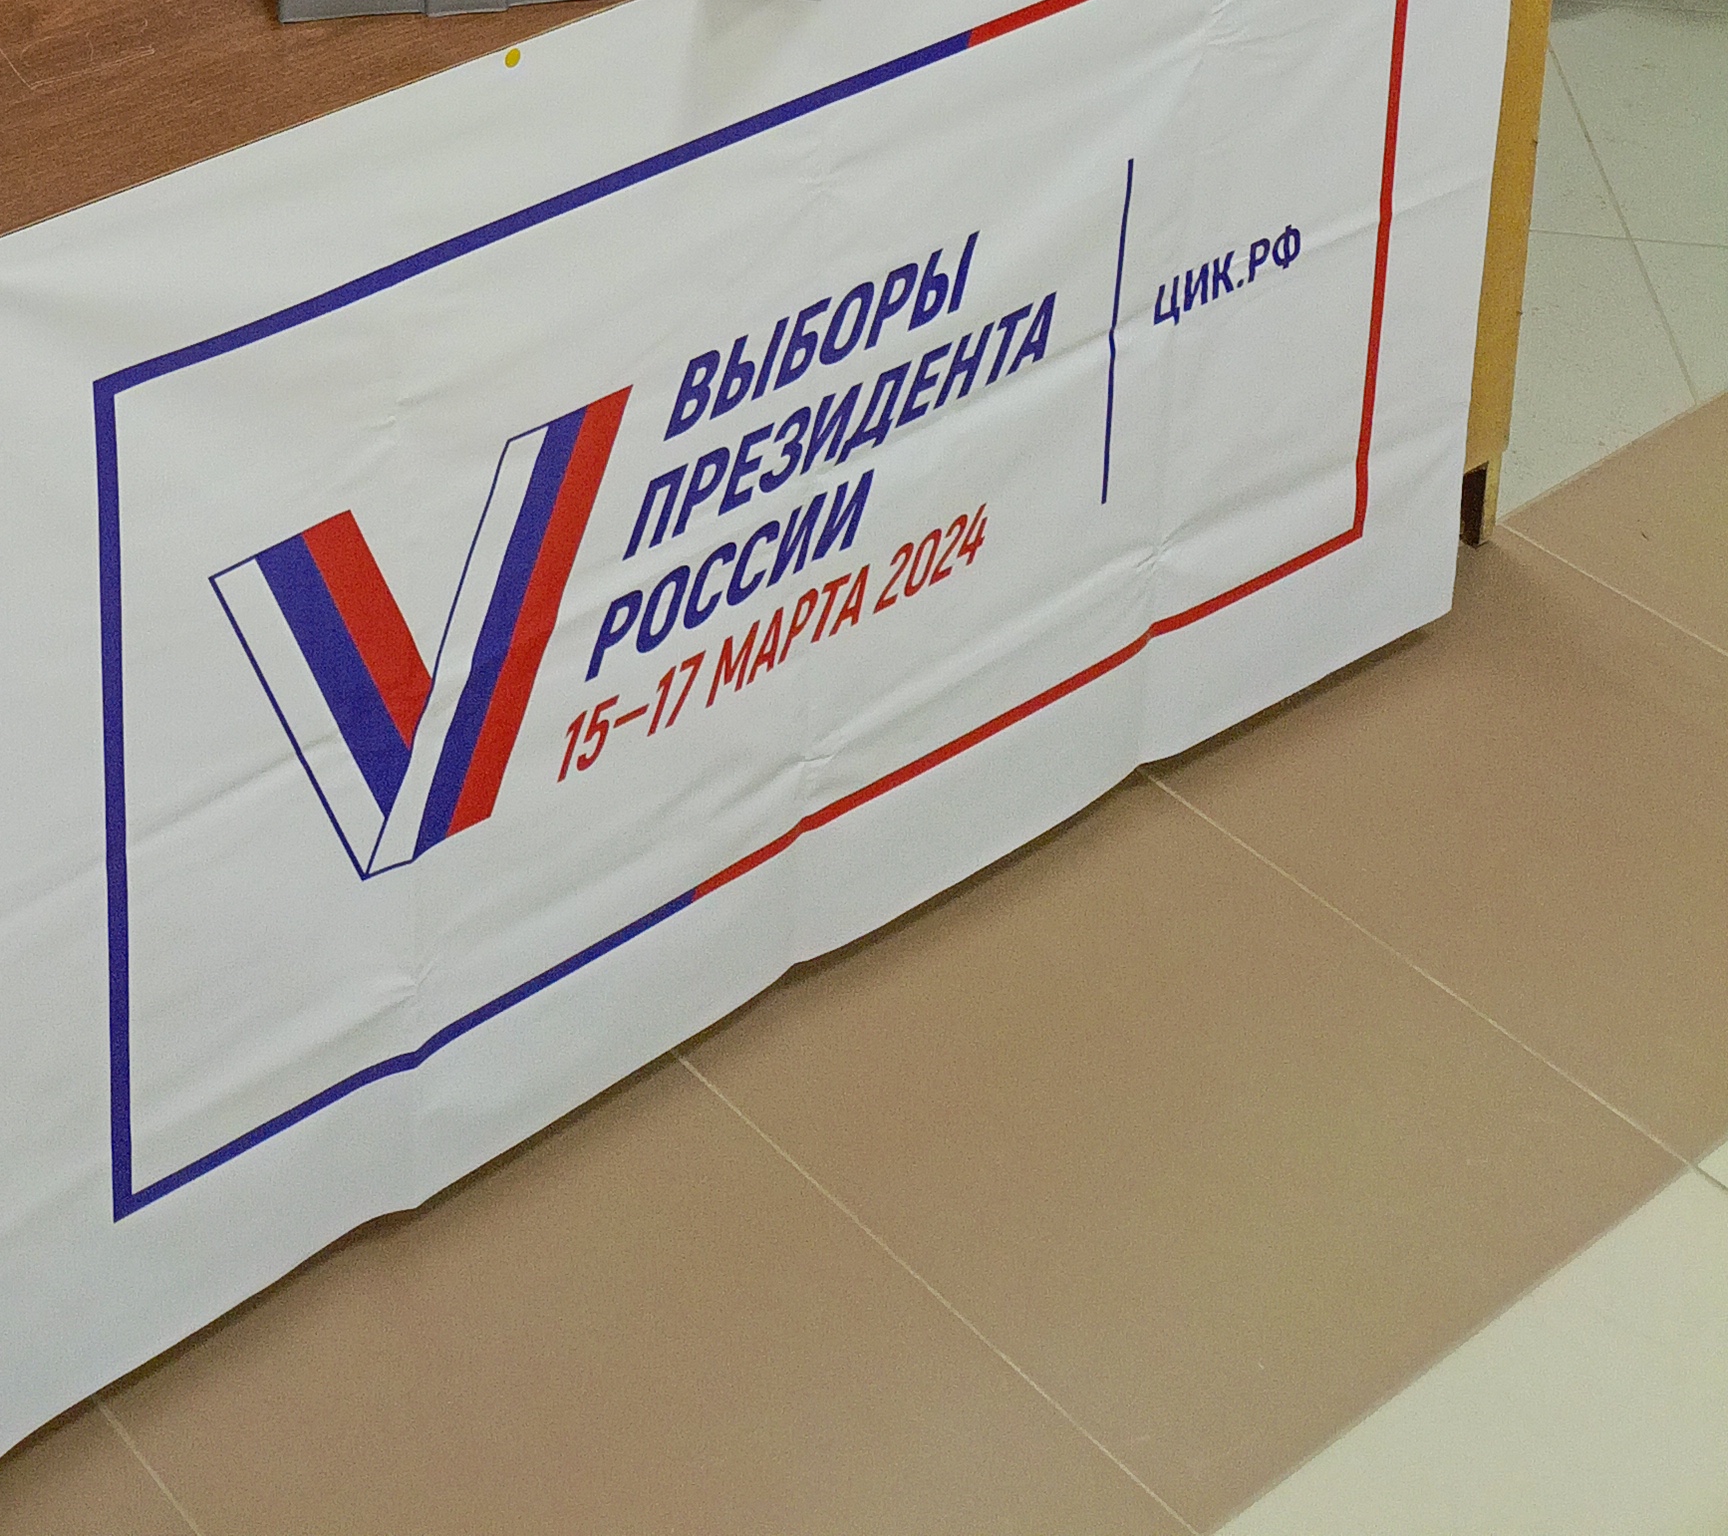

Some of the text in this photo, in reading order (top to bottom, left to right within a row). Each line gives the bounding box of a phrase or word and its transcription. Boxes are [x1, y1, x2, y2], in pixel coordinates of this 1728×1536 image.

[663, 231, 980, 443] ВЫБОРЫ
[1153, 224, 1302, 326] ЦИК.РФ
[622, 292, 1058, 562] ПРЕЗИДЕНТА
[584, 469, 876, 684] РОССИИ
[706, 564, 870, 708] МАРТА
[874, 504, 988, 615] 2024
